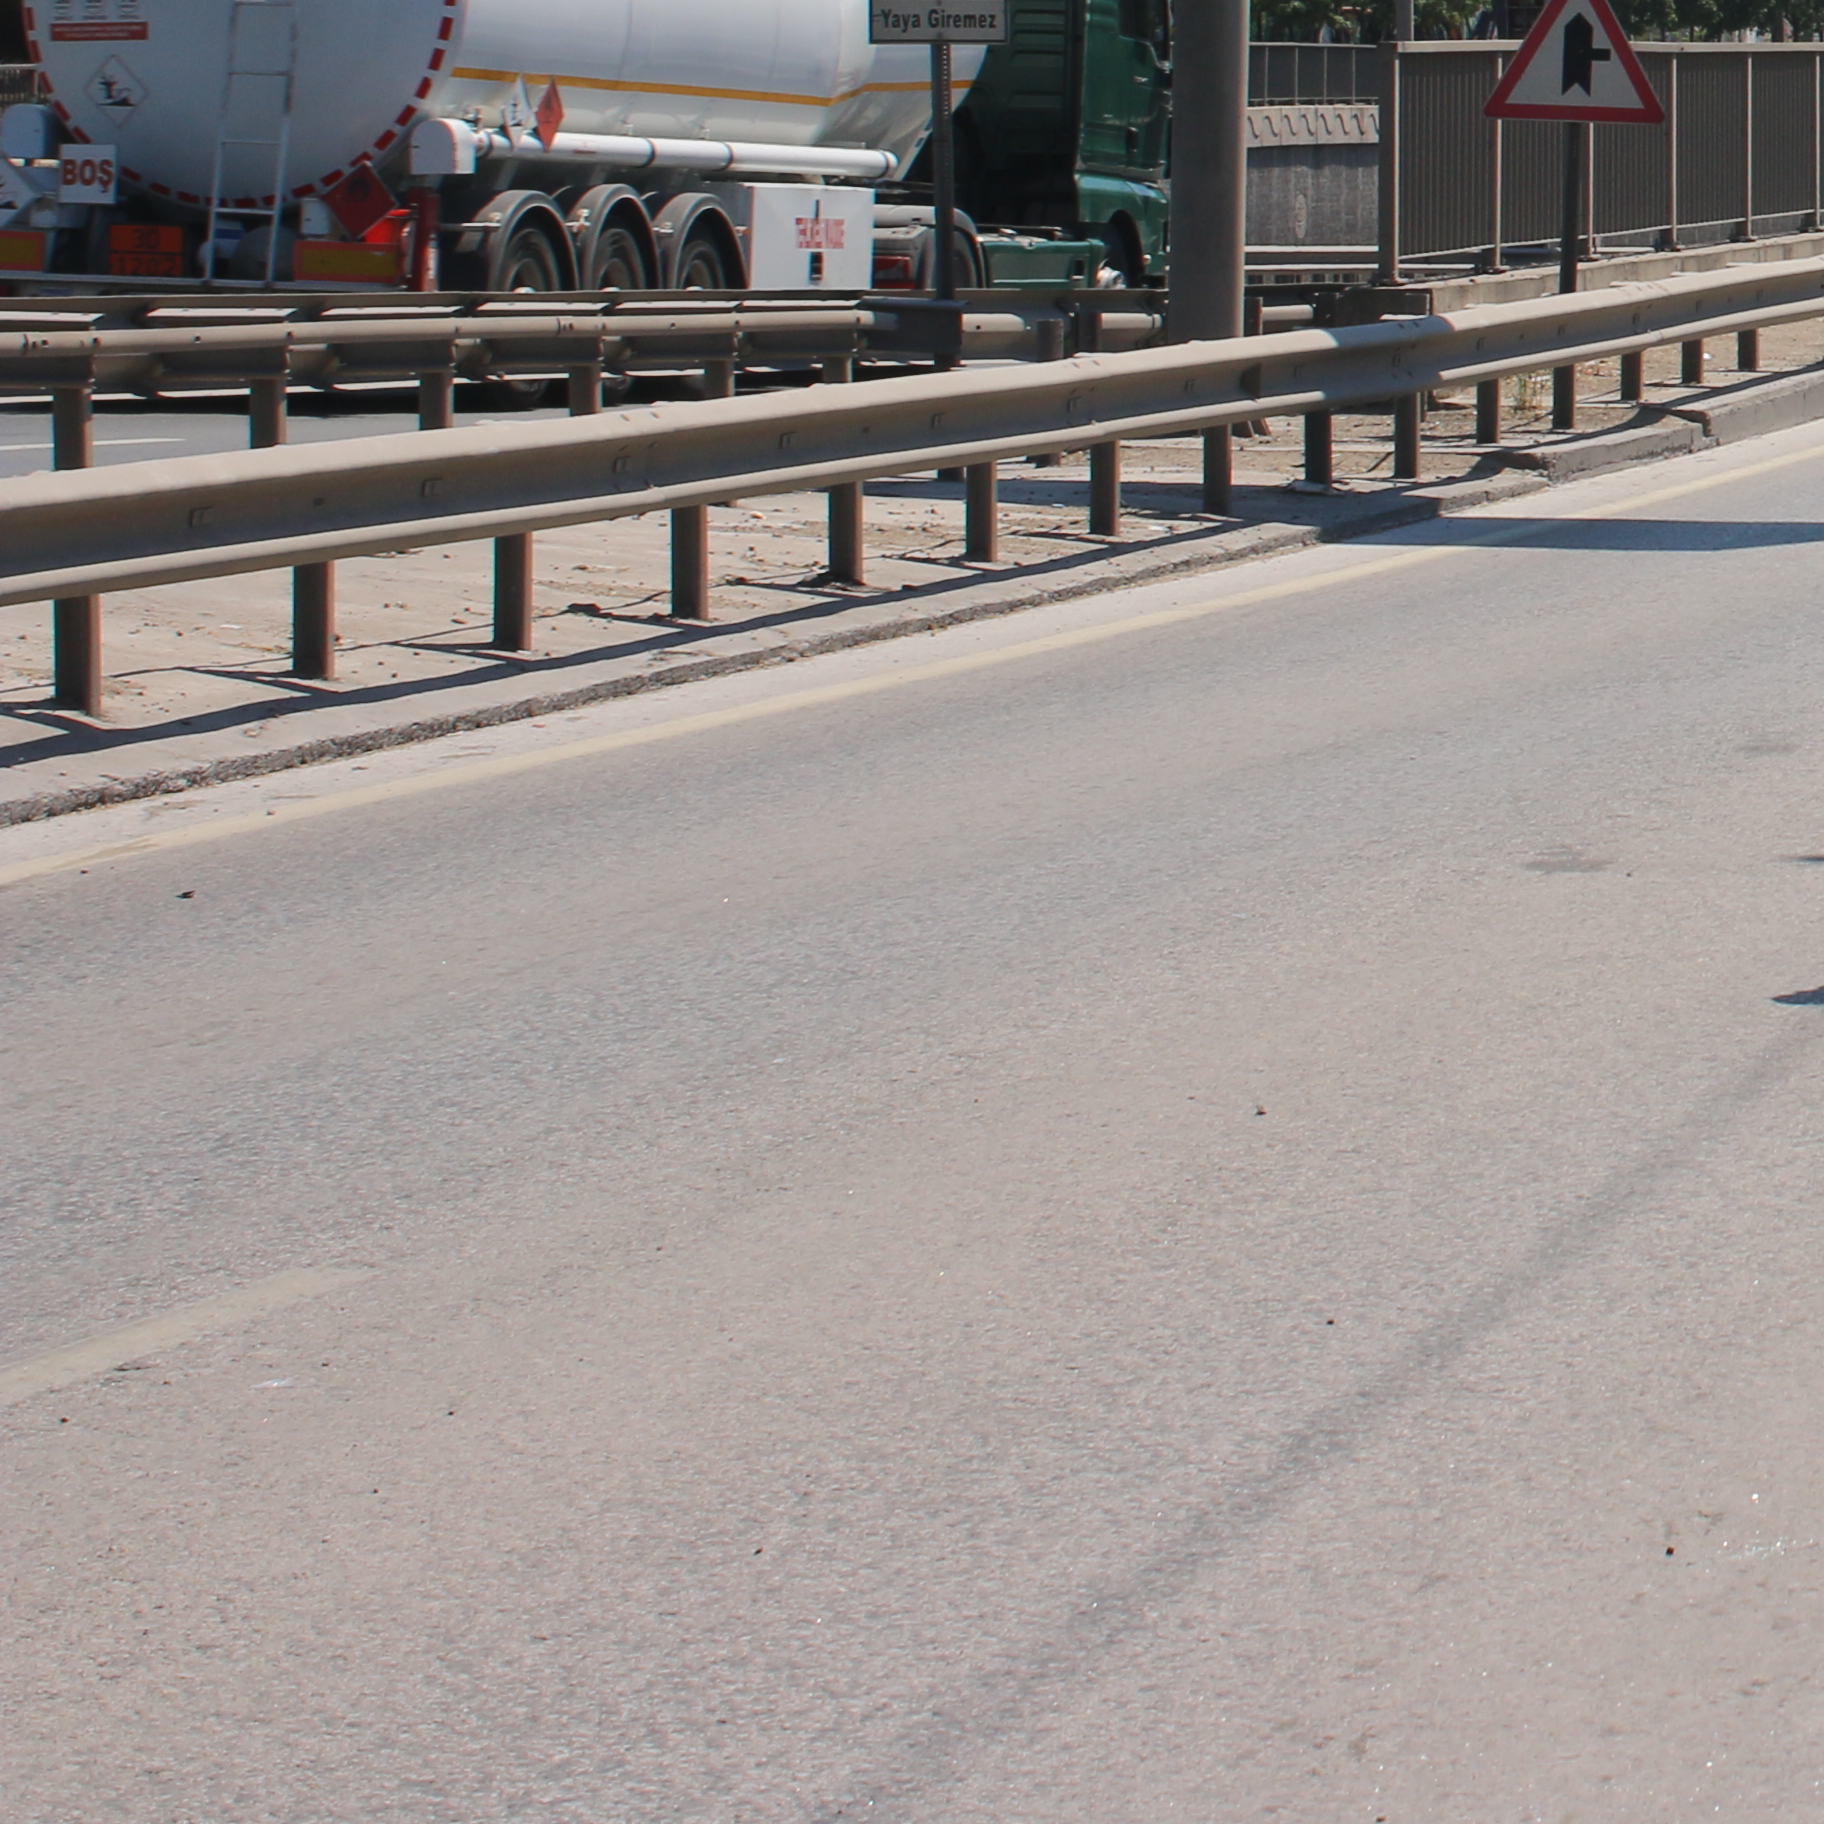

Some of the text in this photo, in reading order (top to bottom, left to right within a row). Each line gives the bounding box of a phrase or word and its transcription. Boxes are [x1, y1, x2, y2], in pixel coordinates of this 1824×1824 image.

[880, 9, 997, 33] Yaya Giremez
[62, 159, 114, 193] BOŞ
